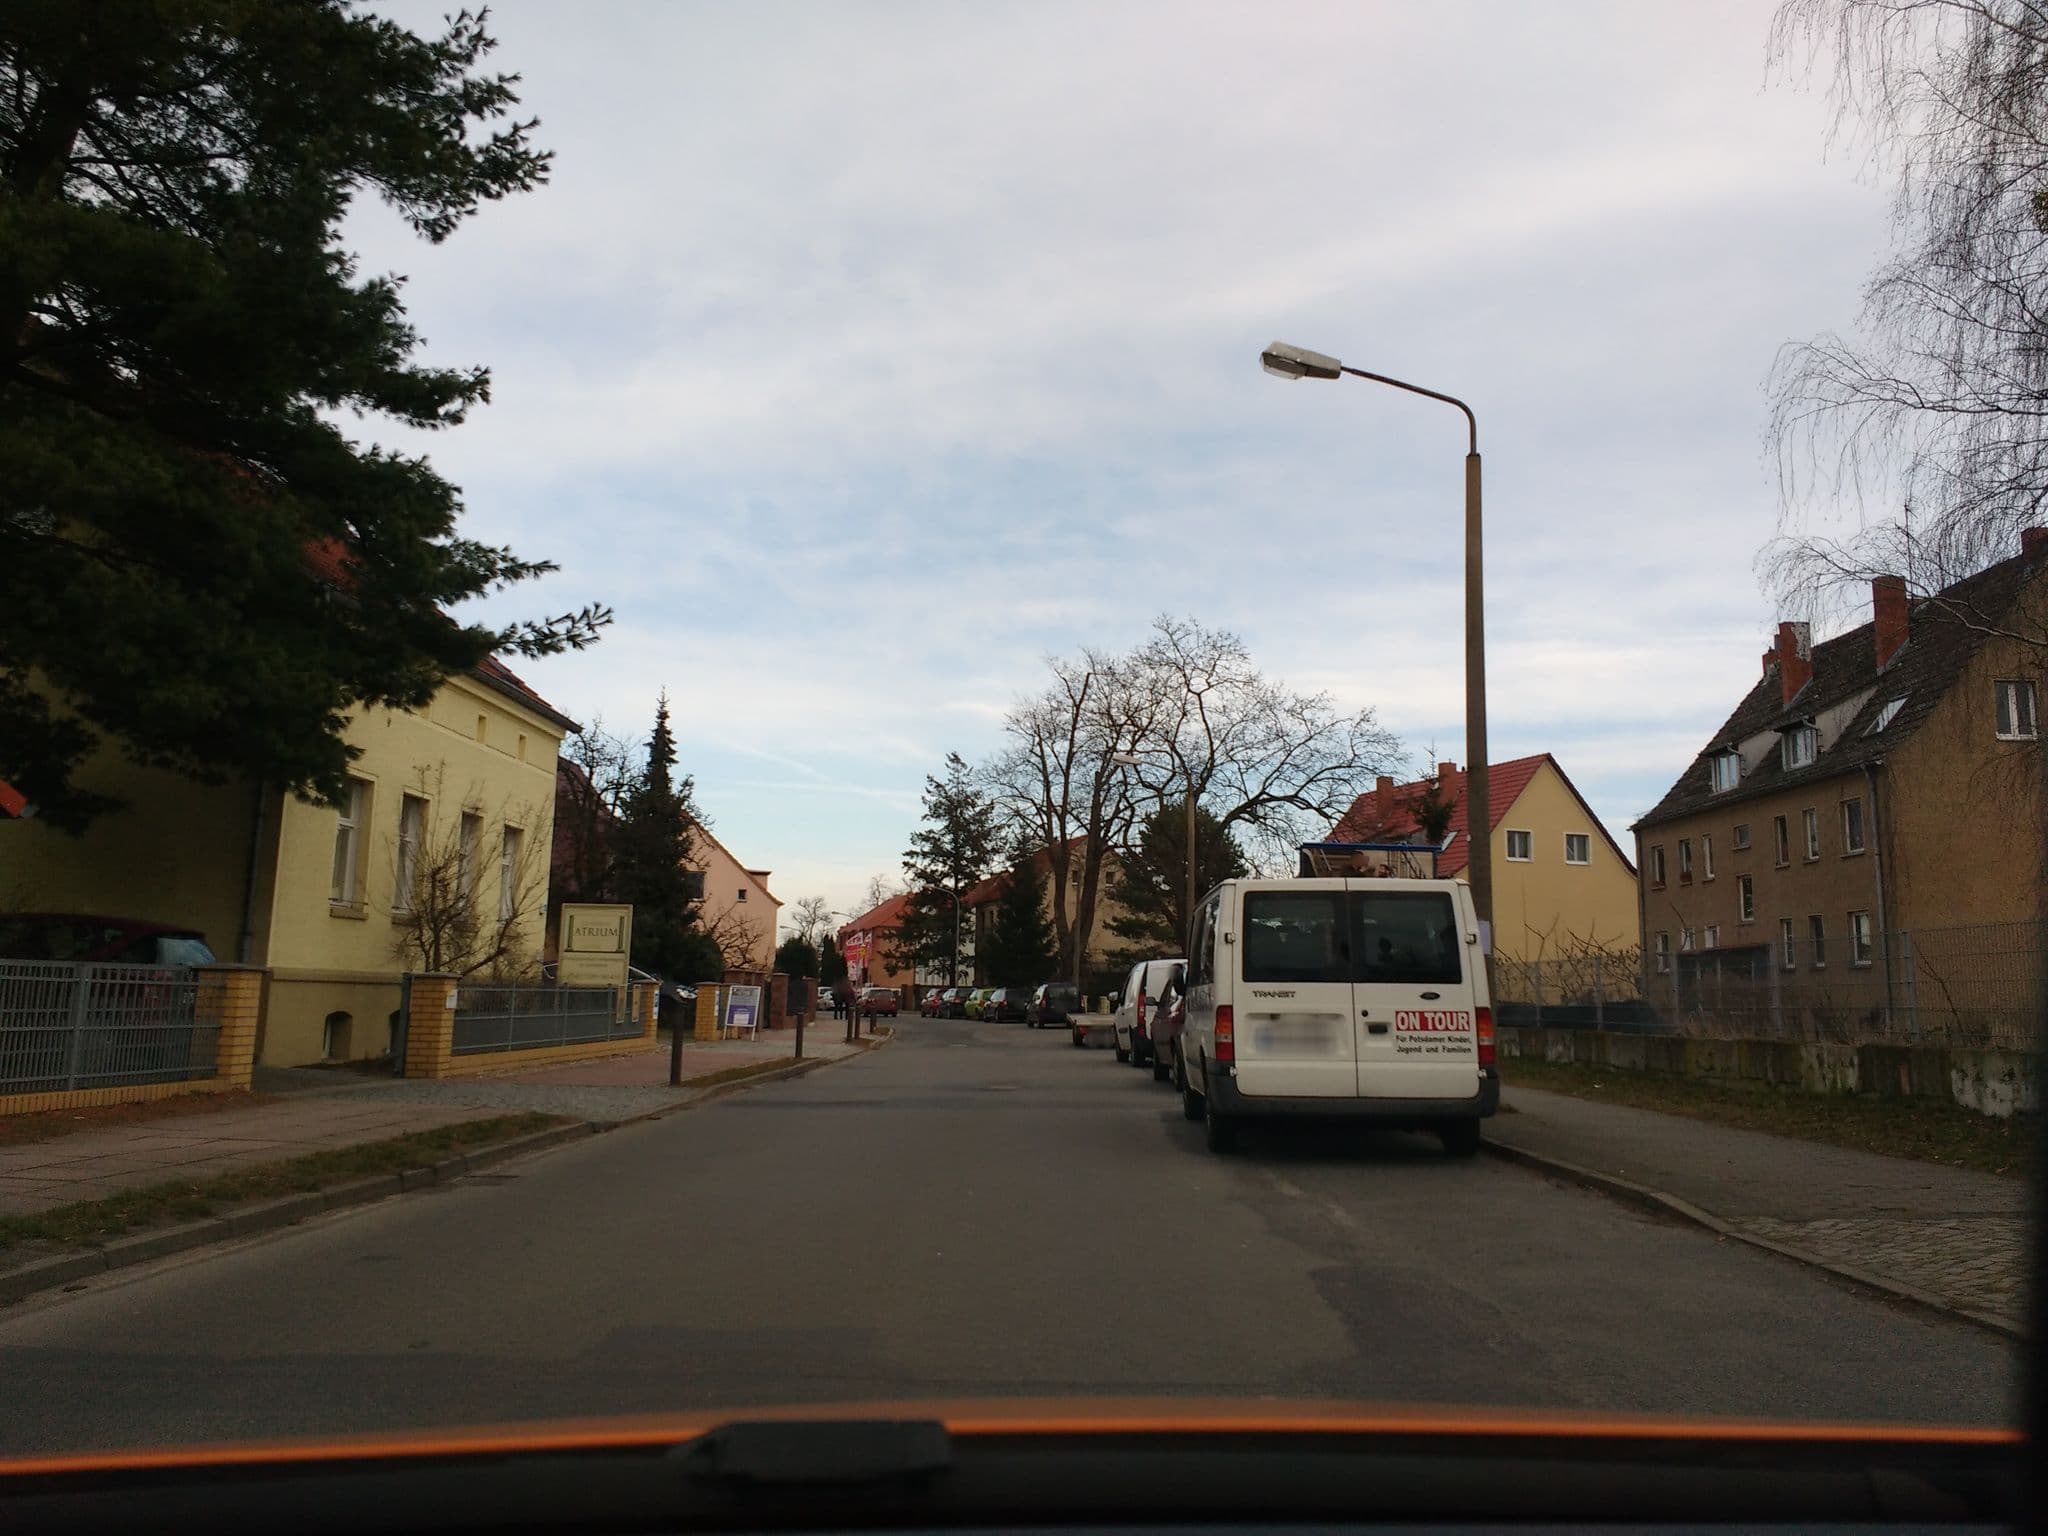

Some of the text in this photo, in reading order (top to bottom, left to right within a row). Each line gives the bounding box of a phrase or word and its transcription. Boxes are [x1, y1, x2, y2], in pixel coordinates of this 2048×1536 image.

[575, 927, 618, 937] ATRIUM
[1252, 990, 1296, 998] TRANSIT
[1397, 1012, 1470, 1031] ON TOUR
